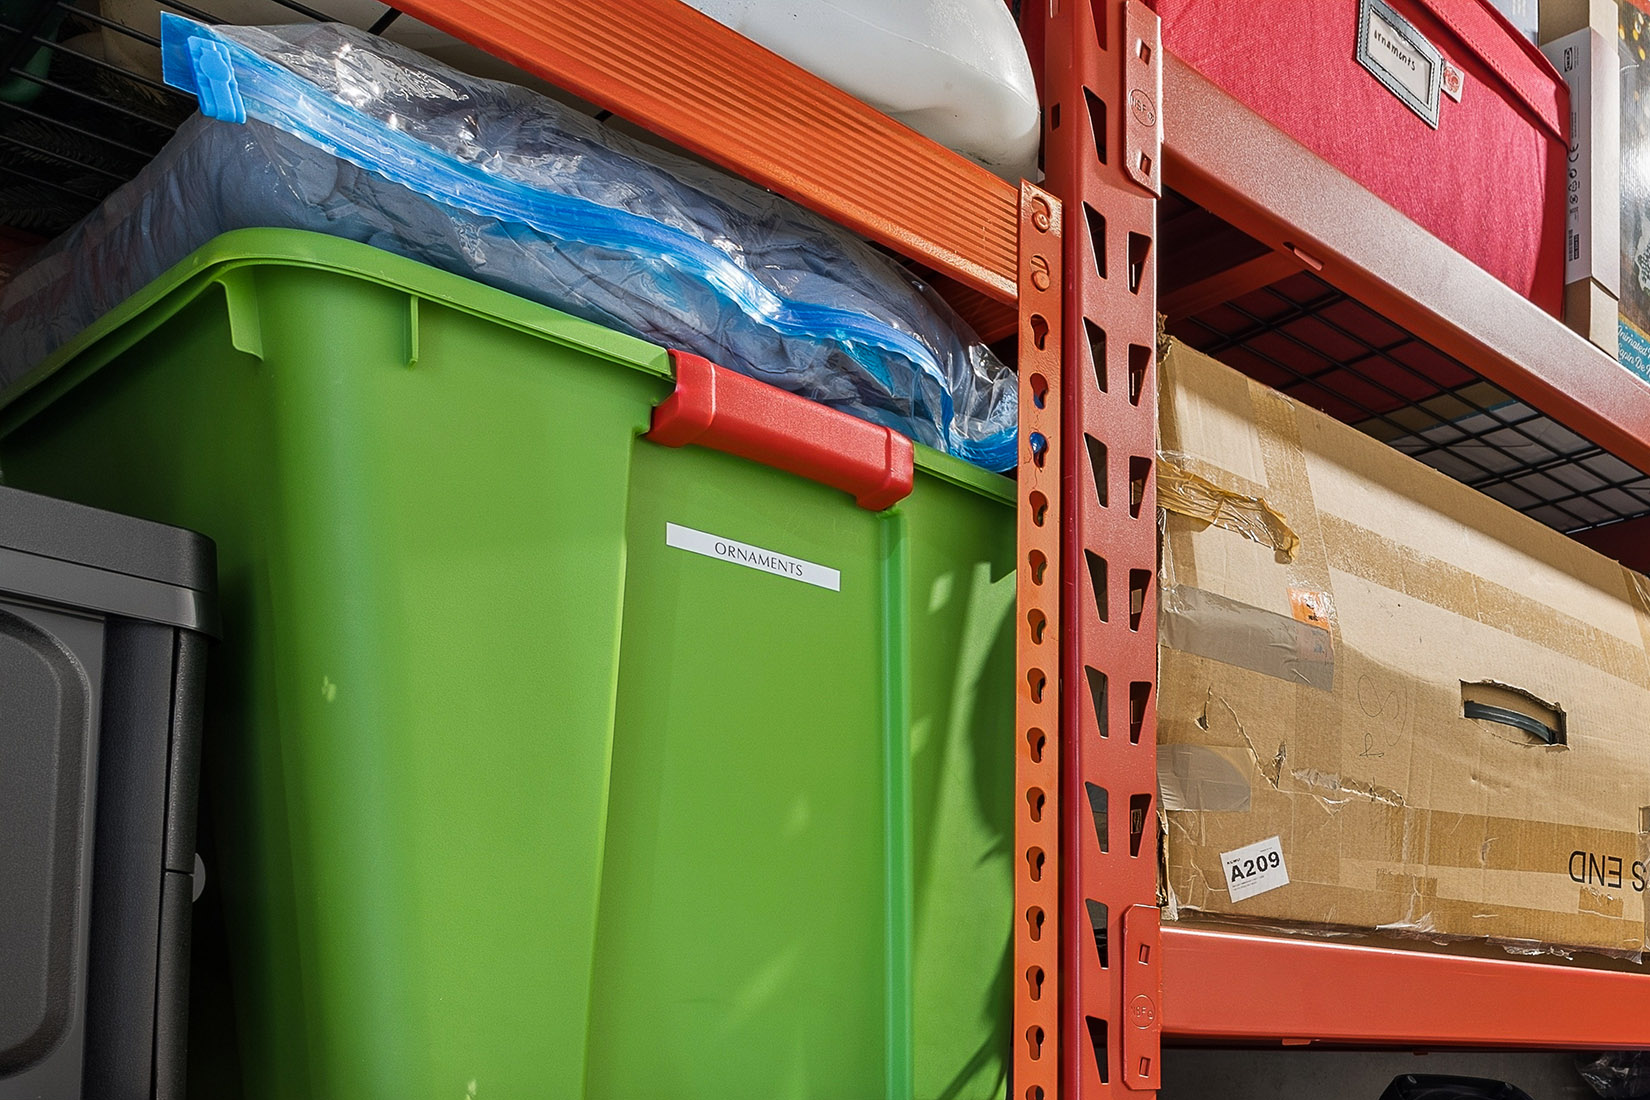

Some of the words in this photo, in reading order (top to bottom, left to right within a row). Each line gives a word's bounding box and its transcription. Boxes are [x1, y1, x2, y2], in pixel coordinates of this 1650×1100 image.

[1635, 356, 1645, 372] De
[714, 542, 803, 576] ORNAMENTS
[1232, 851, 1280, 882] A209
[1568, 850, 1623, 888] END
